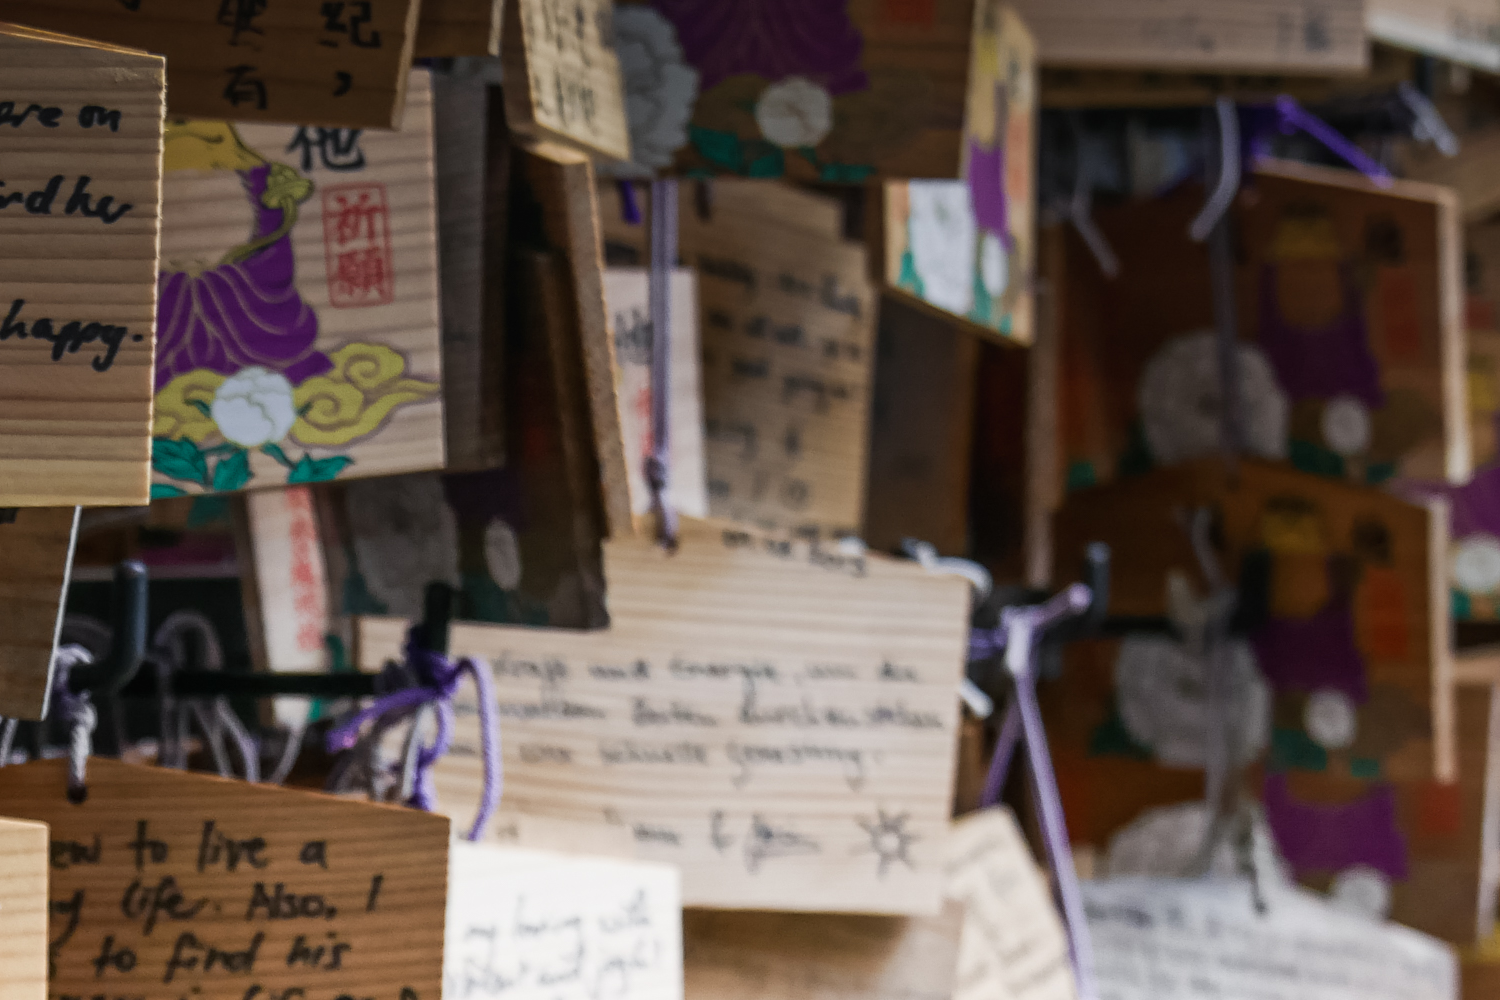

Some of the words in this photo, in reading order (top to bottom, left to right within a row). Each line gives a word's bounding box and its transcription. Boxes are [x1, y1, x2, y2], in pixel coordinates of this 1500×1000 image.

[78, 104, 121, 132] on
[127, 818, 169, 873] to
[196, 818, 269, 873] live
[300, 838, 329, 869] a
[244, 880, 339, 922] Also,
[92, 935, 138, 979] to
[162, 931, 267, 985] find
[286, 930, 353, 972] his
